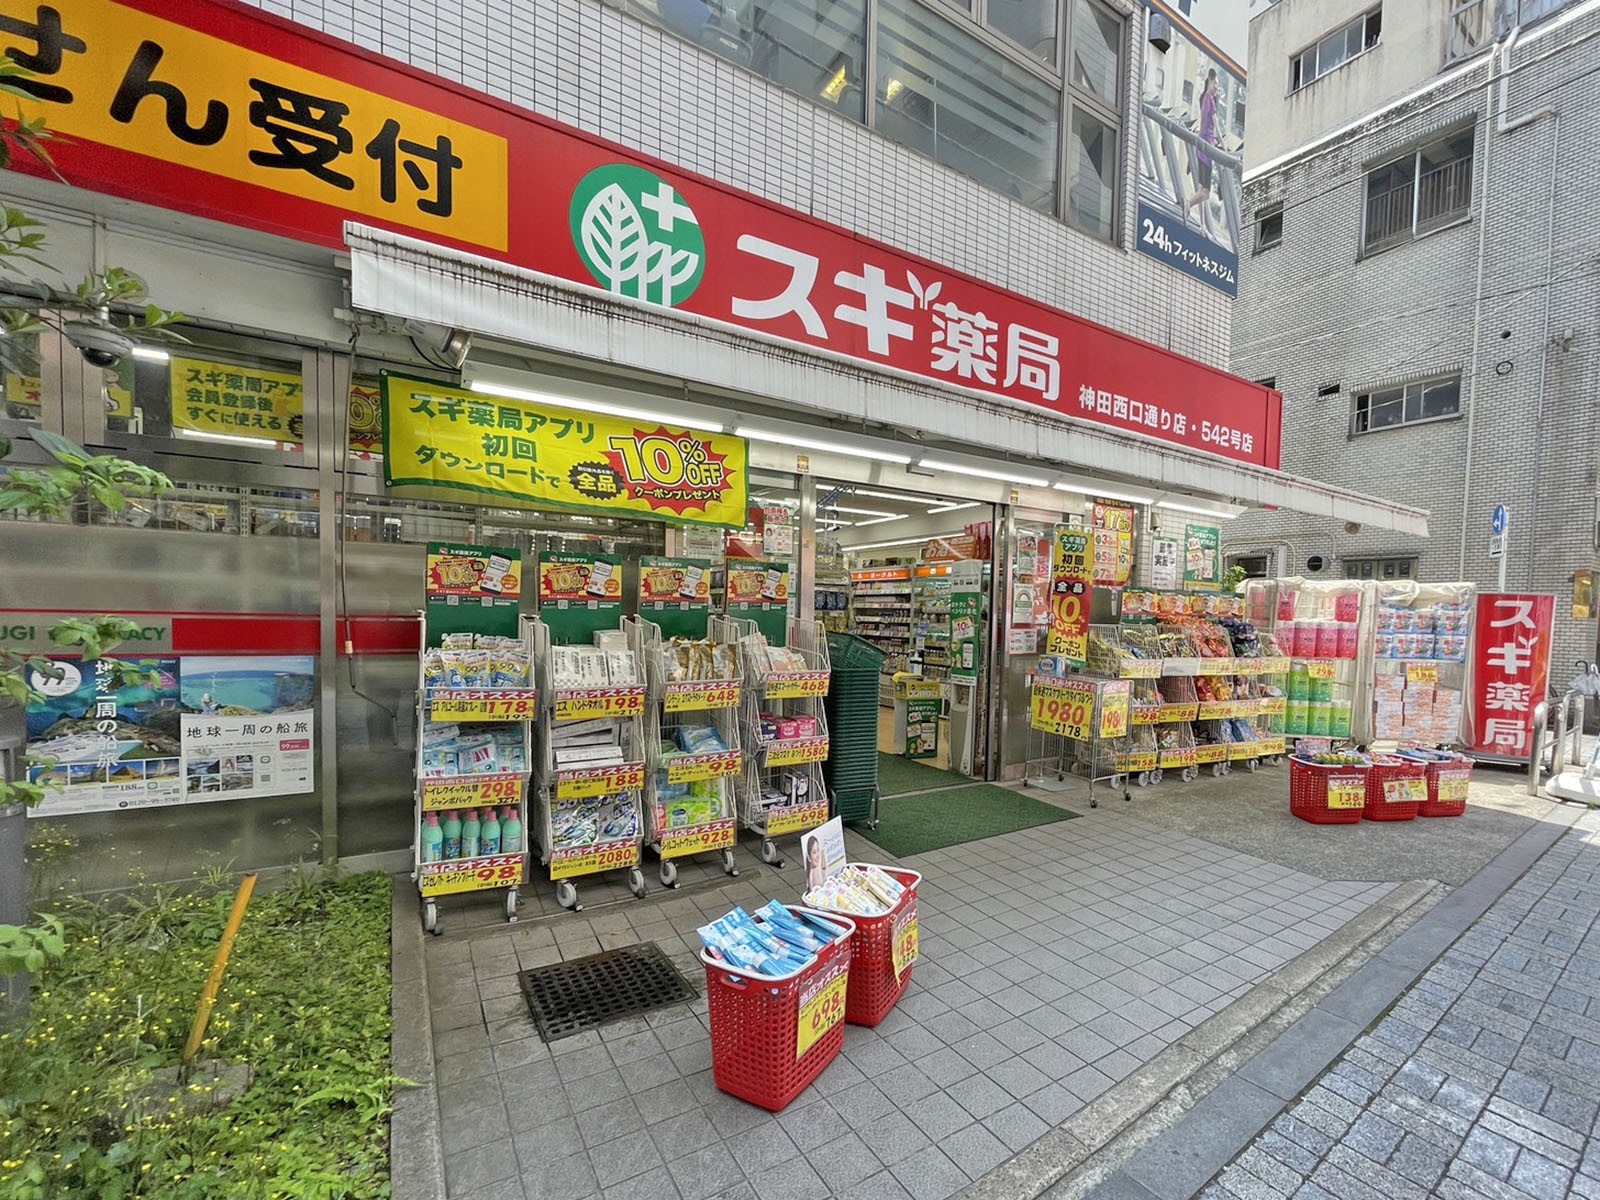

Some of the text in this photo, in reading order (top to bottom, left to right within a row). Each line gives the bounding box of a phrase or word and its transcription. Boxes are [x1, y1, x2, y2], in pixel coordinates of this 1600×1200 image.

[731, 233, 1061, 400] スギ薬局
[409, 393, 595, 444] スギ薬局アプリ
[1078, 384, 1254, 454] 神田西口通り店・542号店
[481, 432, 538, 463] 初回
[576, 472, 617, 494] 全品
[685, 462, 723, 486] OFF
[634, 486, 721, 501] クーポンプレゼント
[1061, 553, 1084, 565] 初回
[1482, 599, 1539, 749] スギ薬局
[186, 722, 308, 739] 地球一周の船旅
